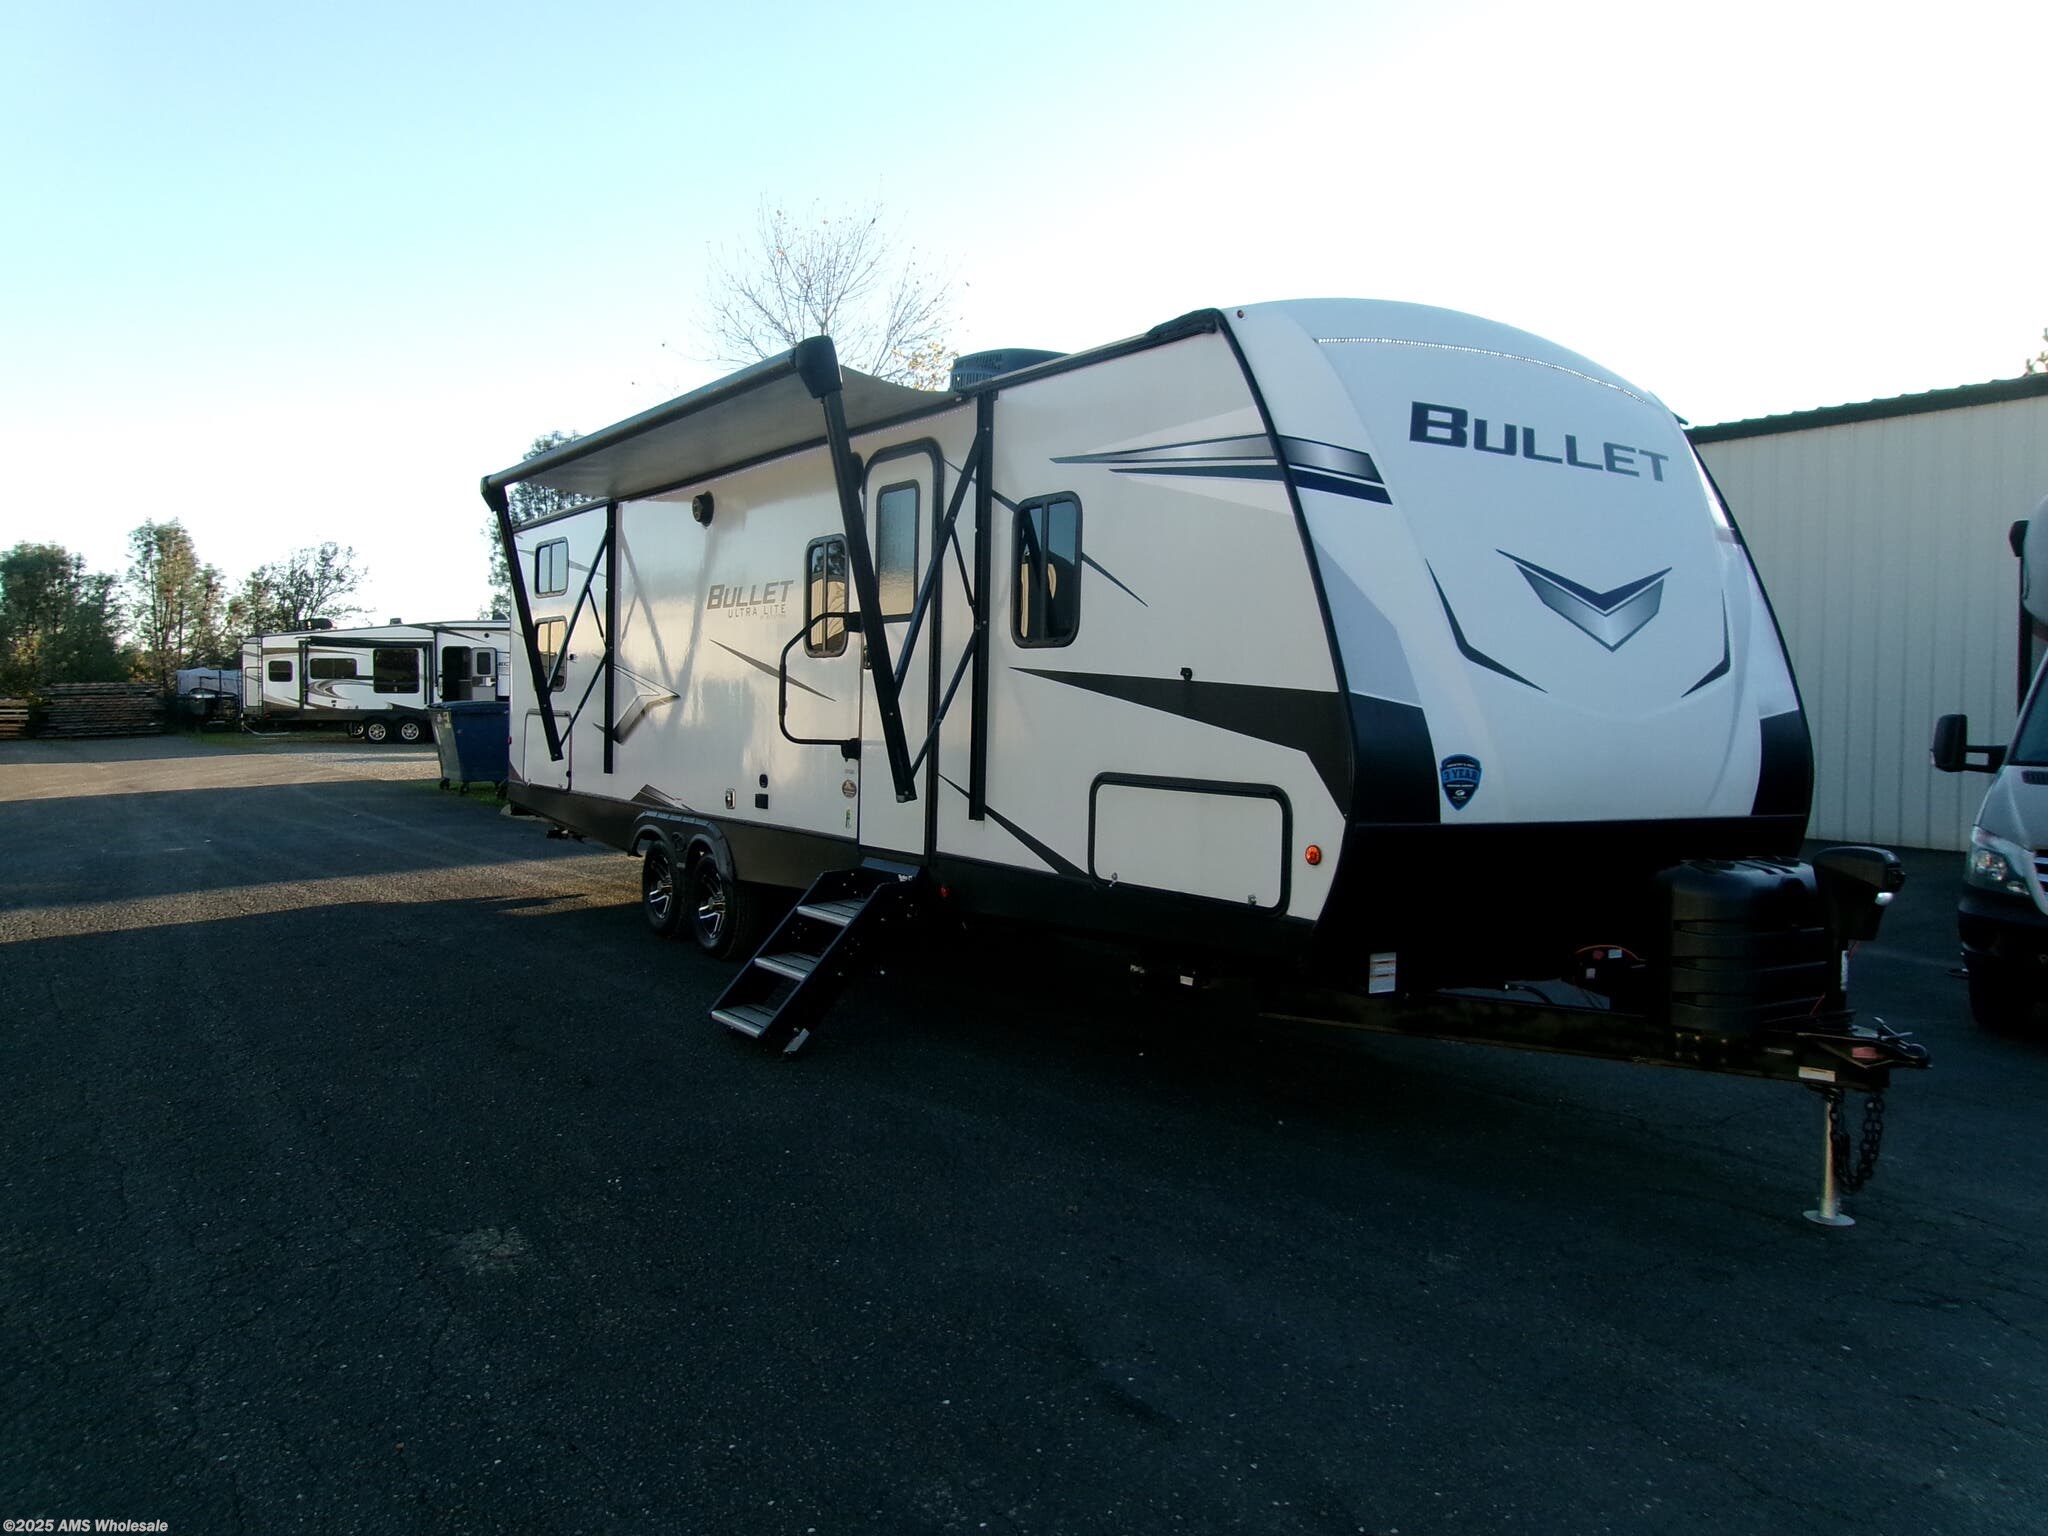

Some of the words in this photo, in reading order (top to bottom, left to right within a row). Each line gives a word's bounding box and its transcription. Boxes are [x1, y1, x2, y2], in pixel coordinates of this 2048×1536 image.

[1409, 401, 1669, 482] BULLET
[706, 580, 794, 609] BULLET
[728, 607, 757, 618] ULTRA
[763, 604, 786, 615] LITE
